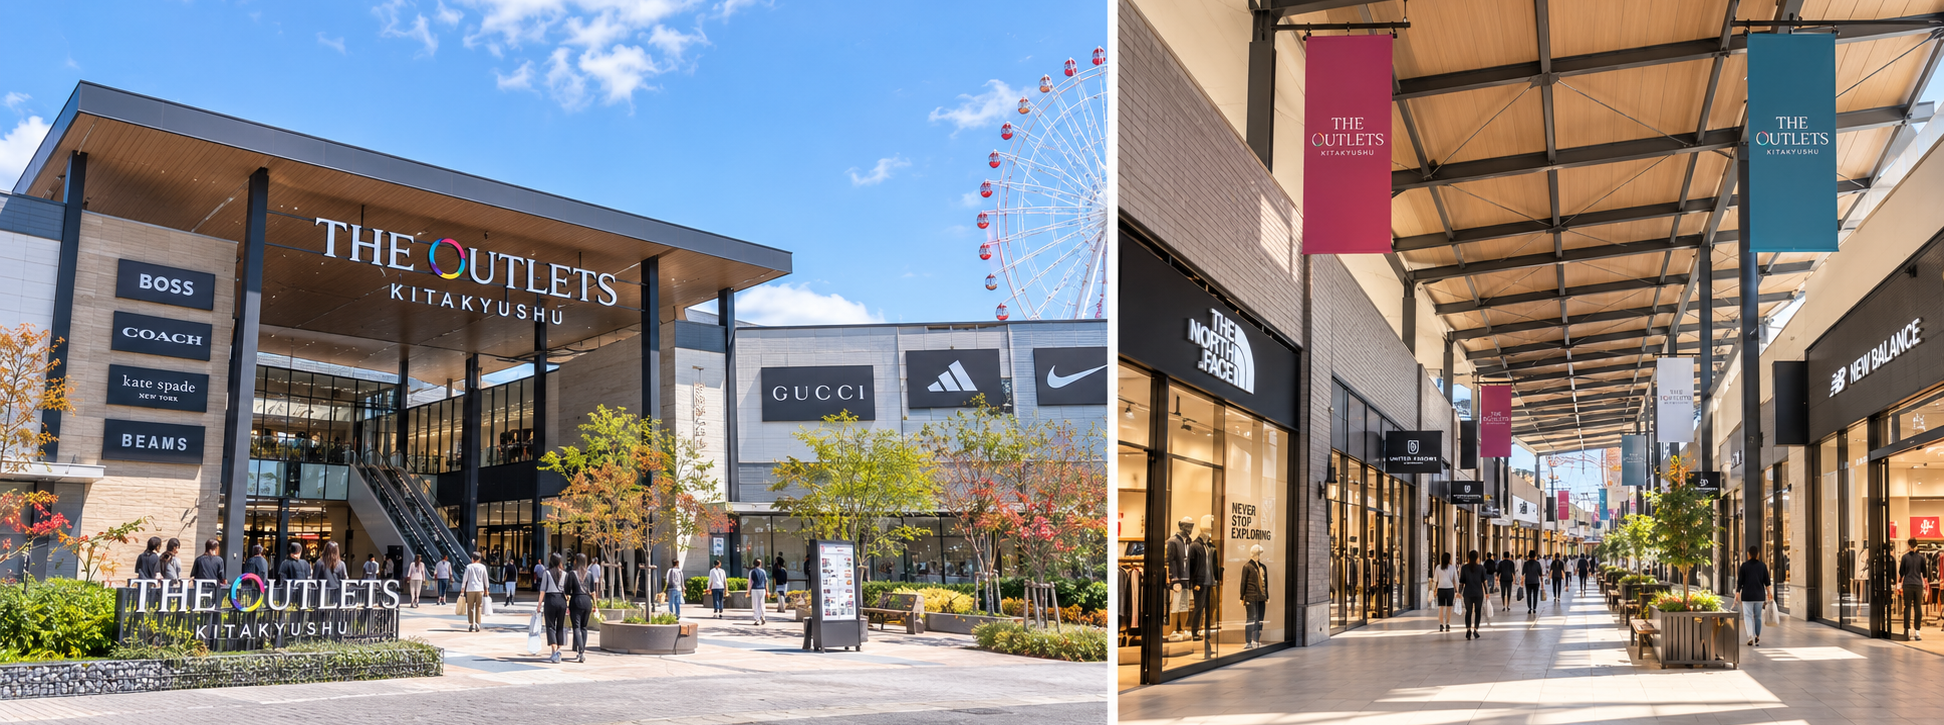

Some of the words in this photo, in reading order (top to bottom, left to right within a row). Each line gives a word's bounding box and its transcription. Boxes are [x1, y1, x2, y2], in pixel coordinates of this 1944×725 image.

[1330, 116, 1365, 131] THE
[1774, 115, 1809, 130] THE
[1311, 132, 1385, 148] OUTLETS
[1755, 130, 1830, 146] OUTLETS
[1320, 149, 1375, 157] KITAKYUSHU
[1766, 148, 1820, 156] KITAKYUSHU
[315, 217, 415, 272] THE
[428, 237, 619, 308] OUTLETS
[139, 273, 195, 297] BOSS
[390, 282, 564, 326] KITAKYUSHU
[1209, 307, 1236, 343] THE
[122, 326, 203, 346] COACH
[1188, 317, 1235, 363] NORTH
[1849, 351, 1871, 385] NEW
[1871, 317, 1921, 371] BALANCE
[1202, 348, 1234, 385] FACE
[122, 374, 153, 390] kate
[157, 378, 196, 394] spade
[772, 384, 864, 402] GUCCI
[121, 433, 188, 451] BEAMS
[1231, 502, 1256, 516] NEVER
[1231, 514, 1252, 527] STOP
[1231, 527, 1271, 541] EXPLORING
[130, 578, 218, 613] THE
[230, 572, 401, 613] OUTLETS
[195, 621, 349, 640] KITAKYUSHU
